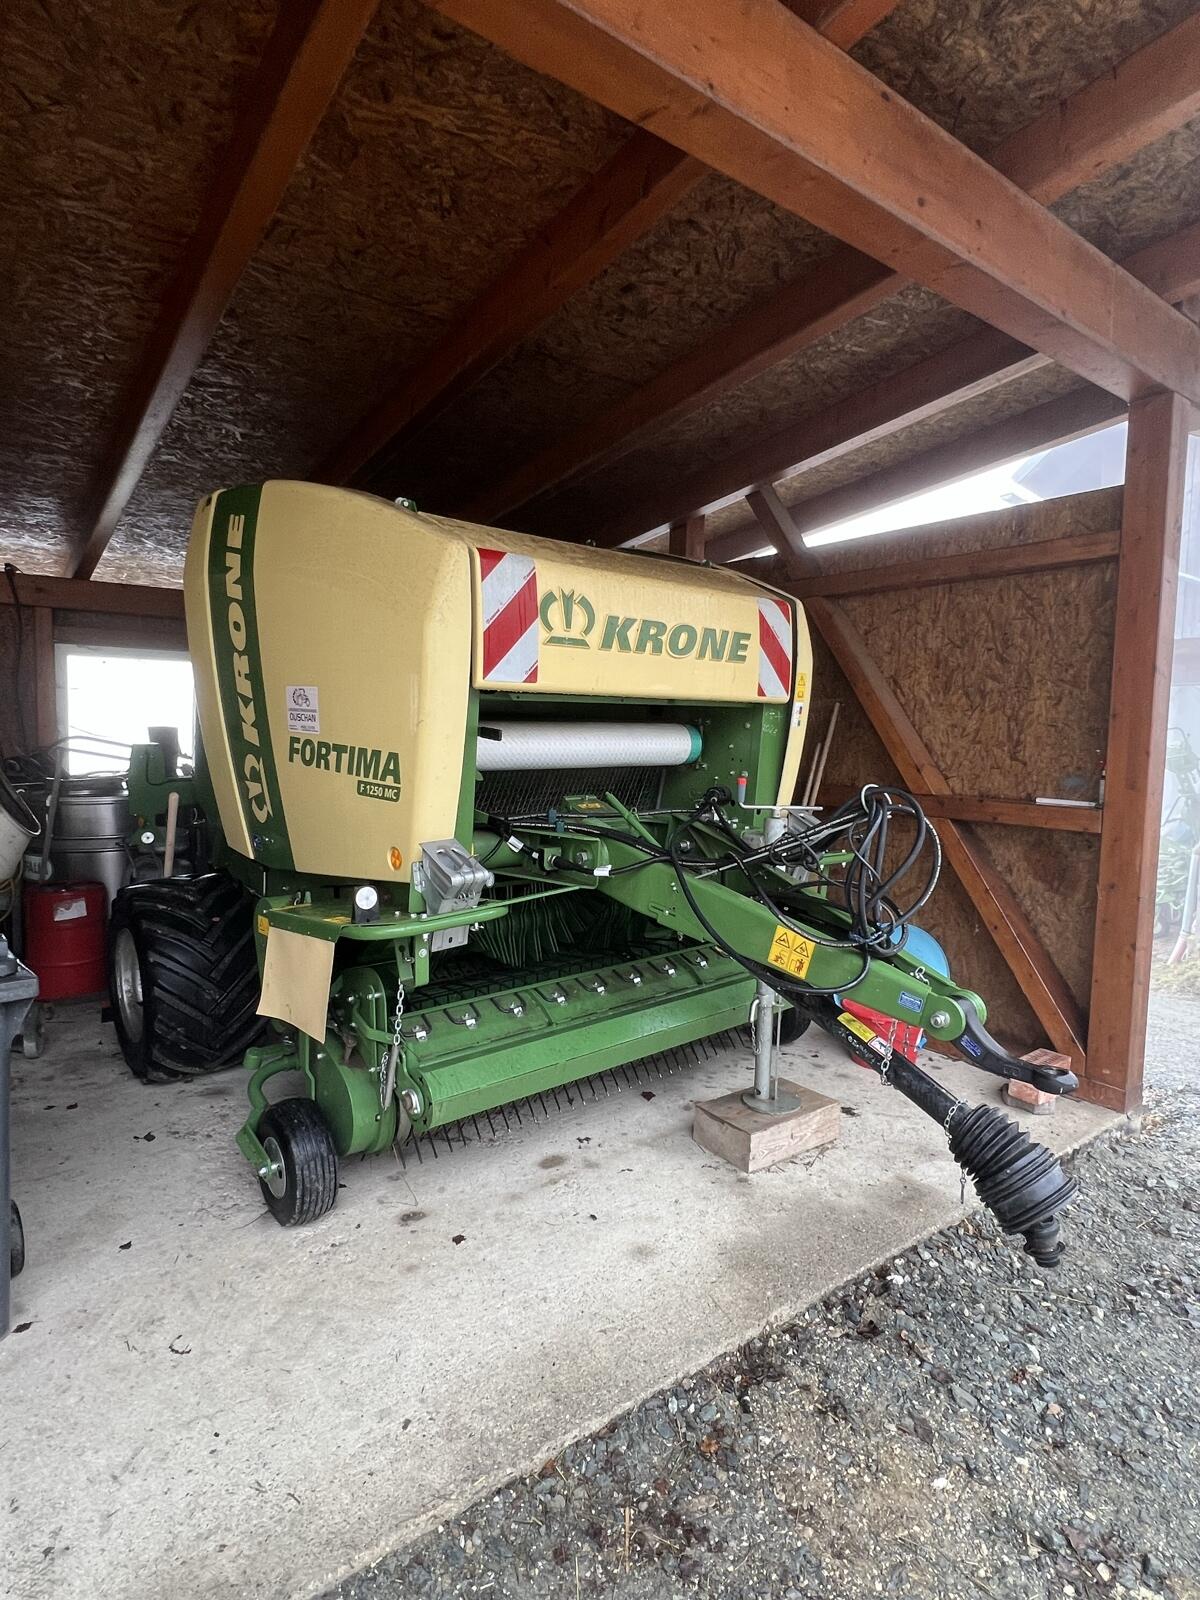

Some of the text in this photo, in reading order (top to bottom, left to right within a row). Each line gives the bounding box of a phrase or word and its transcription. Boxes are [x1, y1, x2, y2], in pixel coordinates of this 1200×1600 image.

[225, 514, 260, 747] KRONE
[599, 614, 752, 663] KRONE
[288, 736, 401, 784] FORTIMA
[360, 783, 398, 799] F 1250 MC
